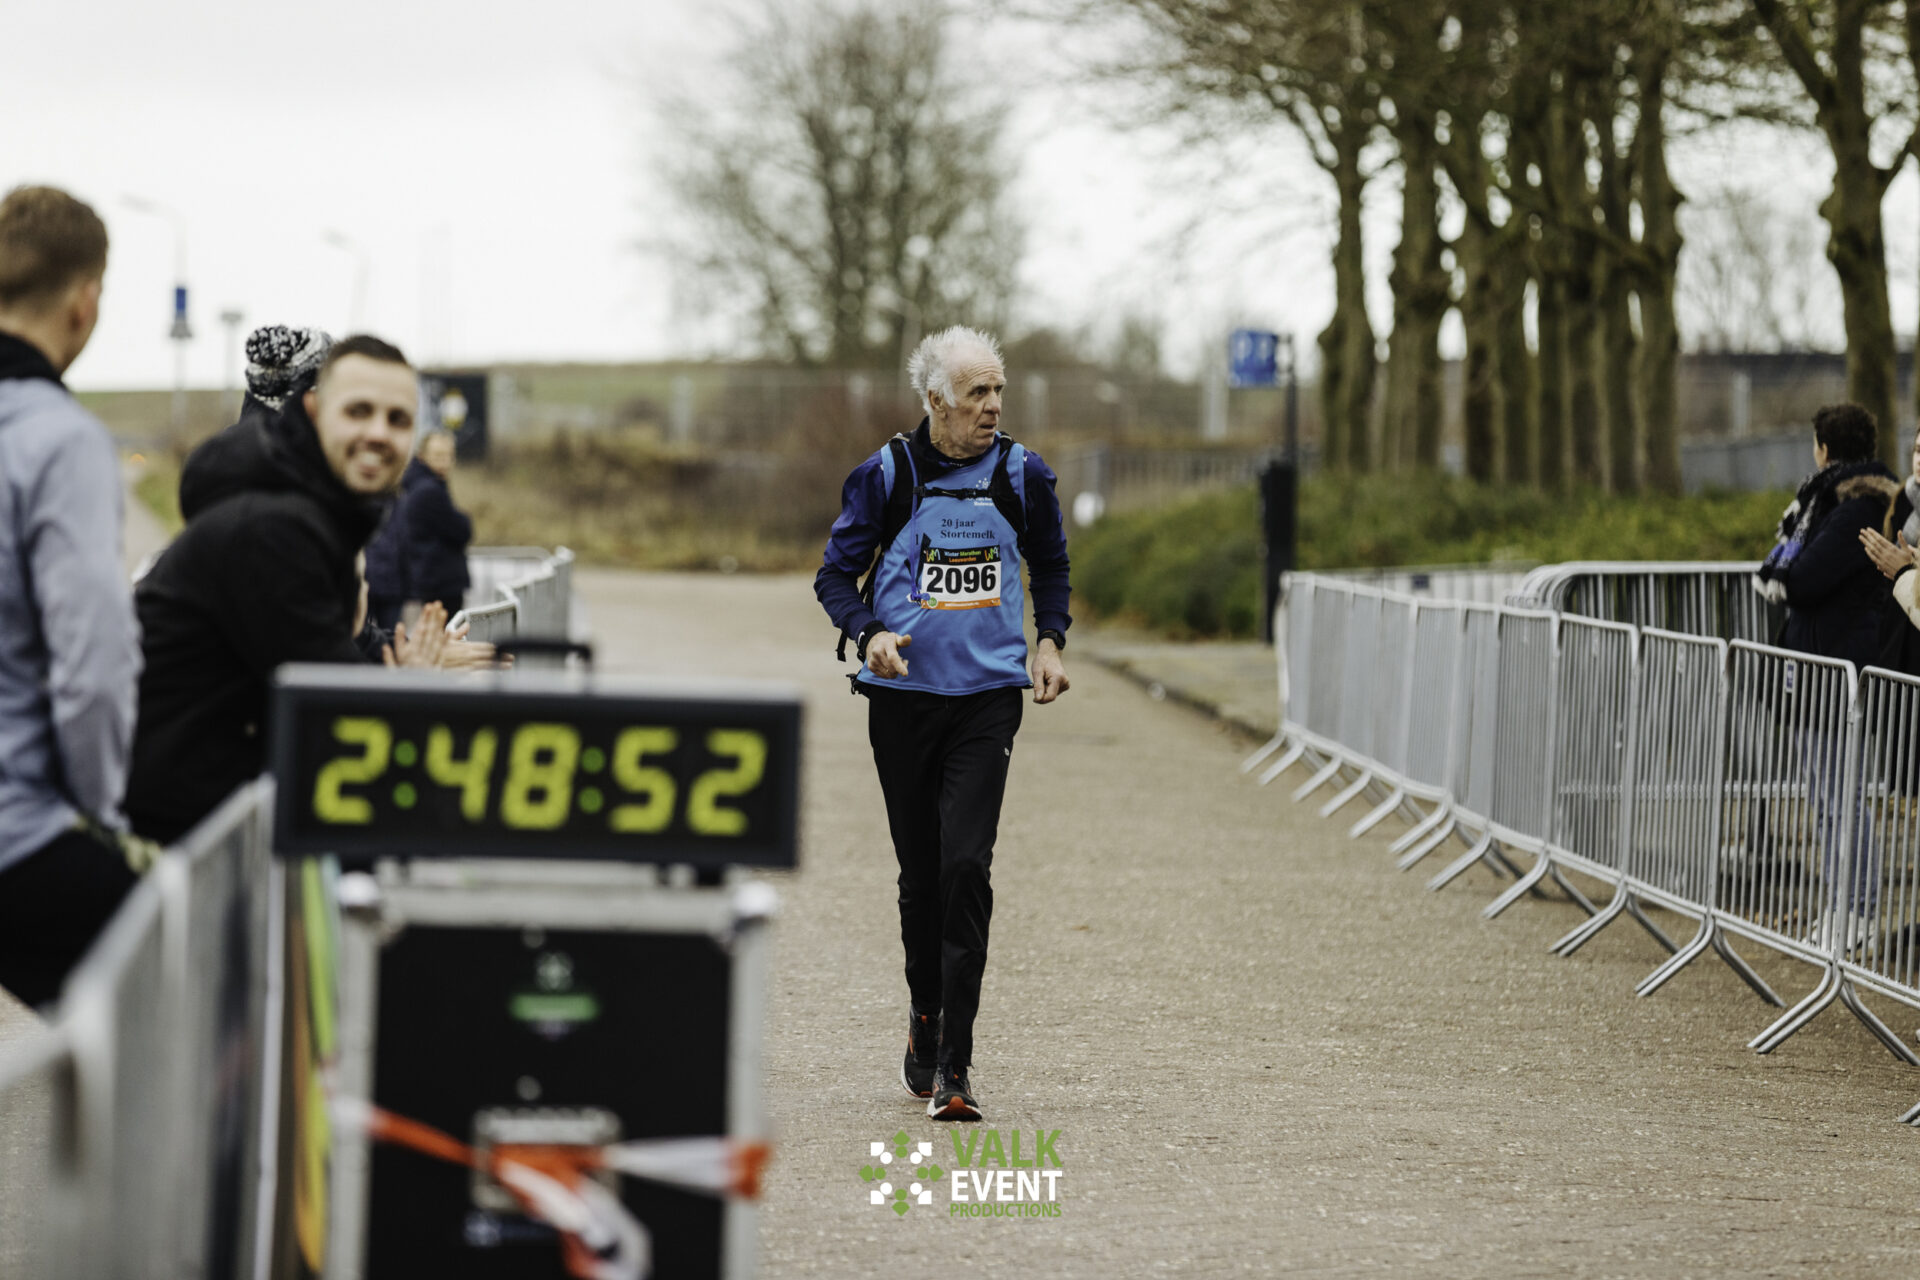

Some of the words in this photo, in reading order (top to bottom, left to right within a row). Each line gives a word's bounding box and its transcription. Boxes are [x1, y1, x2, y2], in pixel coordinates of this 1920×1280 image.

[941, 518, 953, 528] 20
[955, 518, 976, 529] jaar
[940, 529, 996, 540] Stortemelk
[960, 549, 982, 557] Marathon
[926, 564, 997, 595] 2096
[312, 715, 768, 836] 2:48:52
